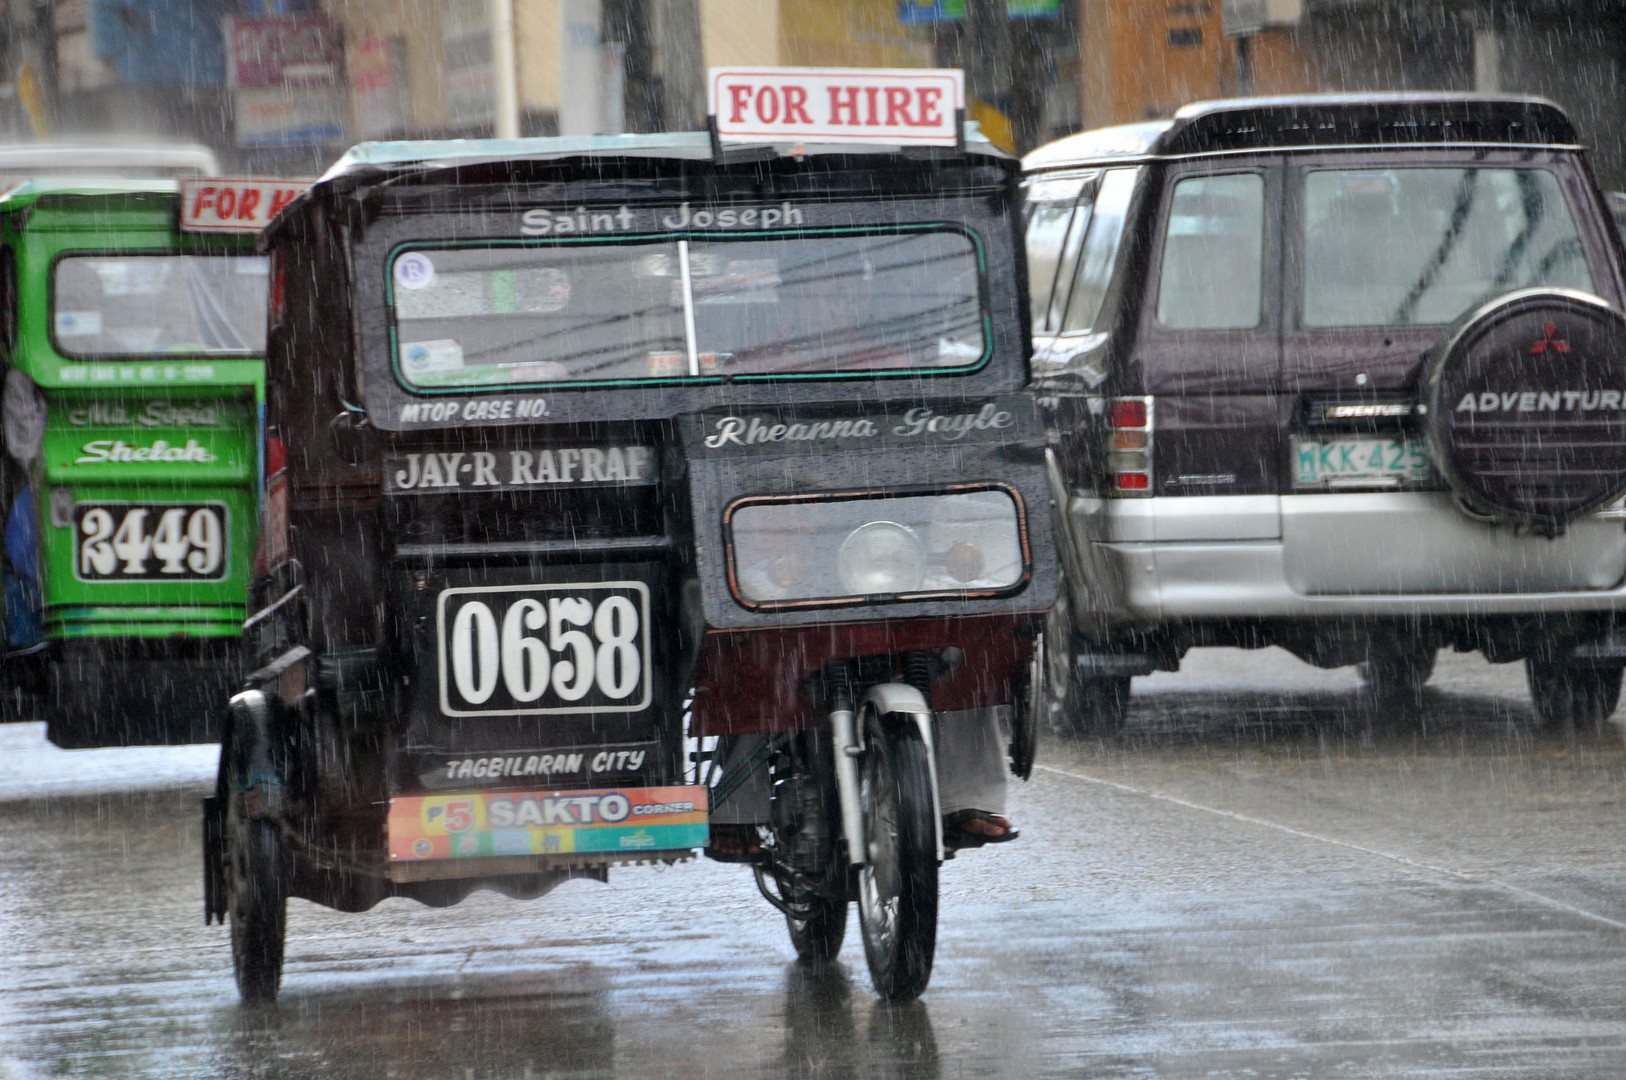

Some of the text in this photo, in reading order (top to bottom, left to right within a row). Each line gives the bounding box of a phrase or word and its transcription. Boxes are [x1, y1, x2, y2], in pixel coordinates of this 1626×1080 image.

[727, 84, 943, 127] FOR HIRE
[192, 186, 260, 220] FOR
[520, 202, 804, 236] Saint Joseph
[400, 398, 550, 423] MTOP CASE NO.
[1456, 389, 1626, 413] ADVENTUR
[703, 403, 1015, 449] Rheanna Gayle
[74, 440, 218, 465] Shelah
[395, 446, 650, 490] JAY-R RAFRAF
[80, 507, 223, 575] 2449
[451, 595, 642, 705] 0658
[446, 750, 646, 779] TAGBILARAN CITY
[489, 793, 631, 828] SAKTO
[632, 802, 695, 815] CORNER
